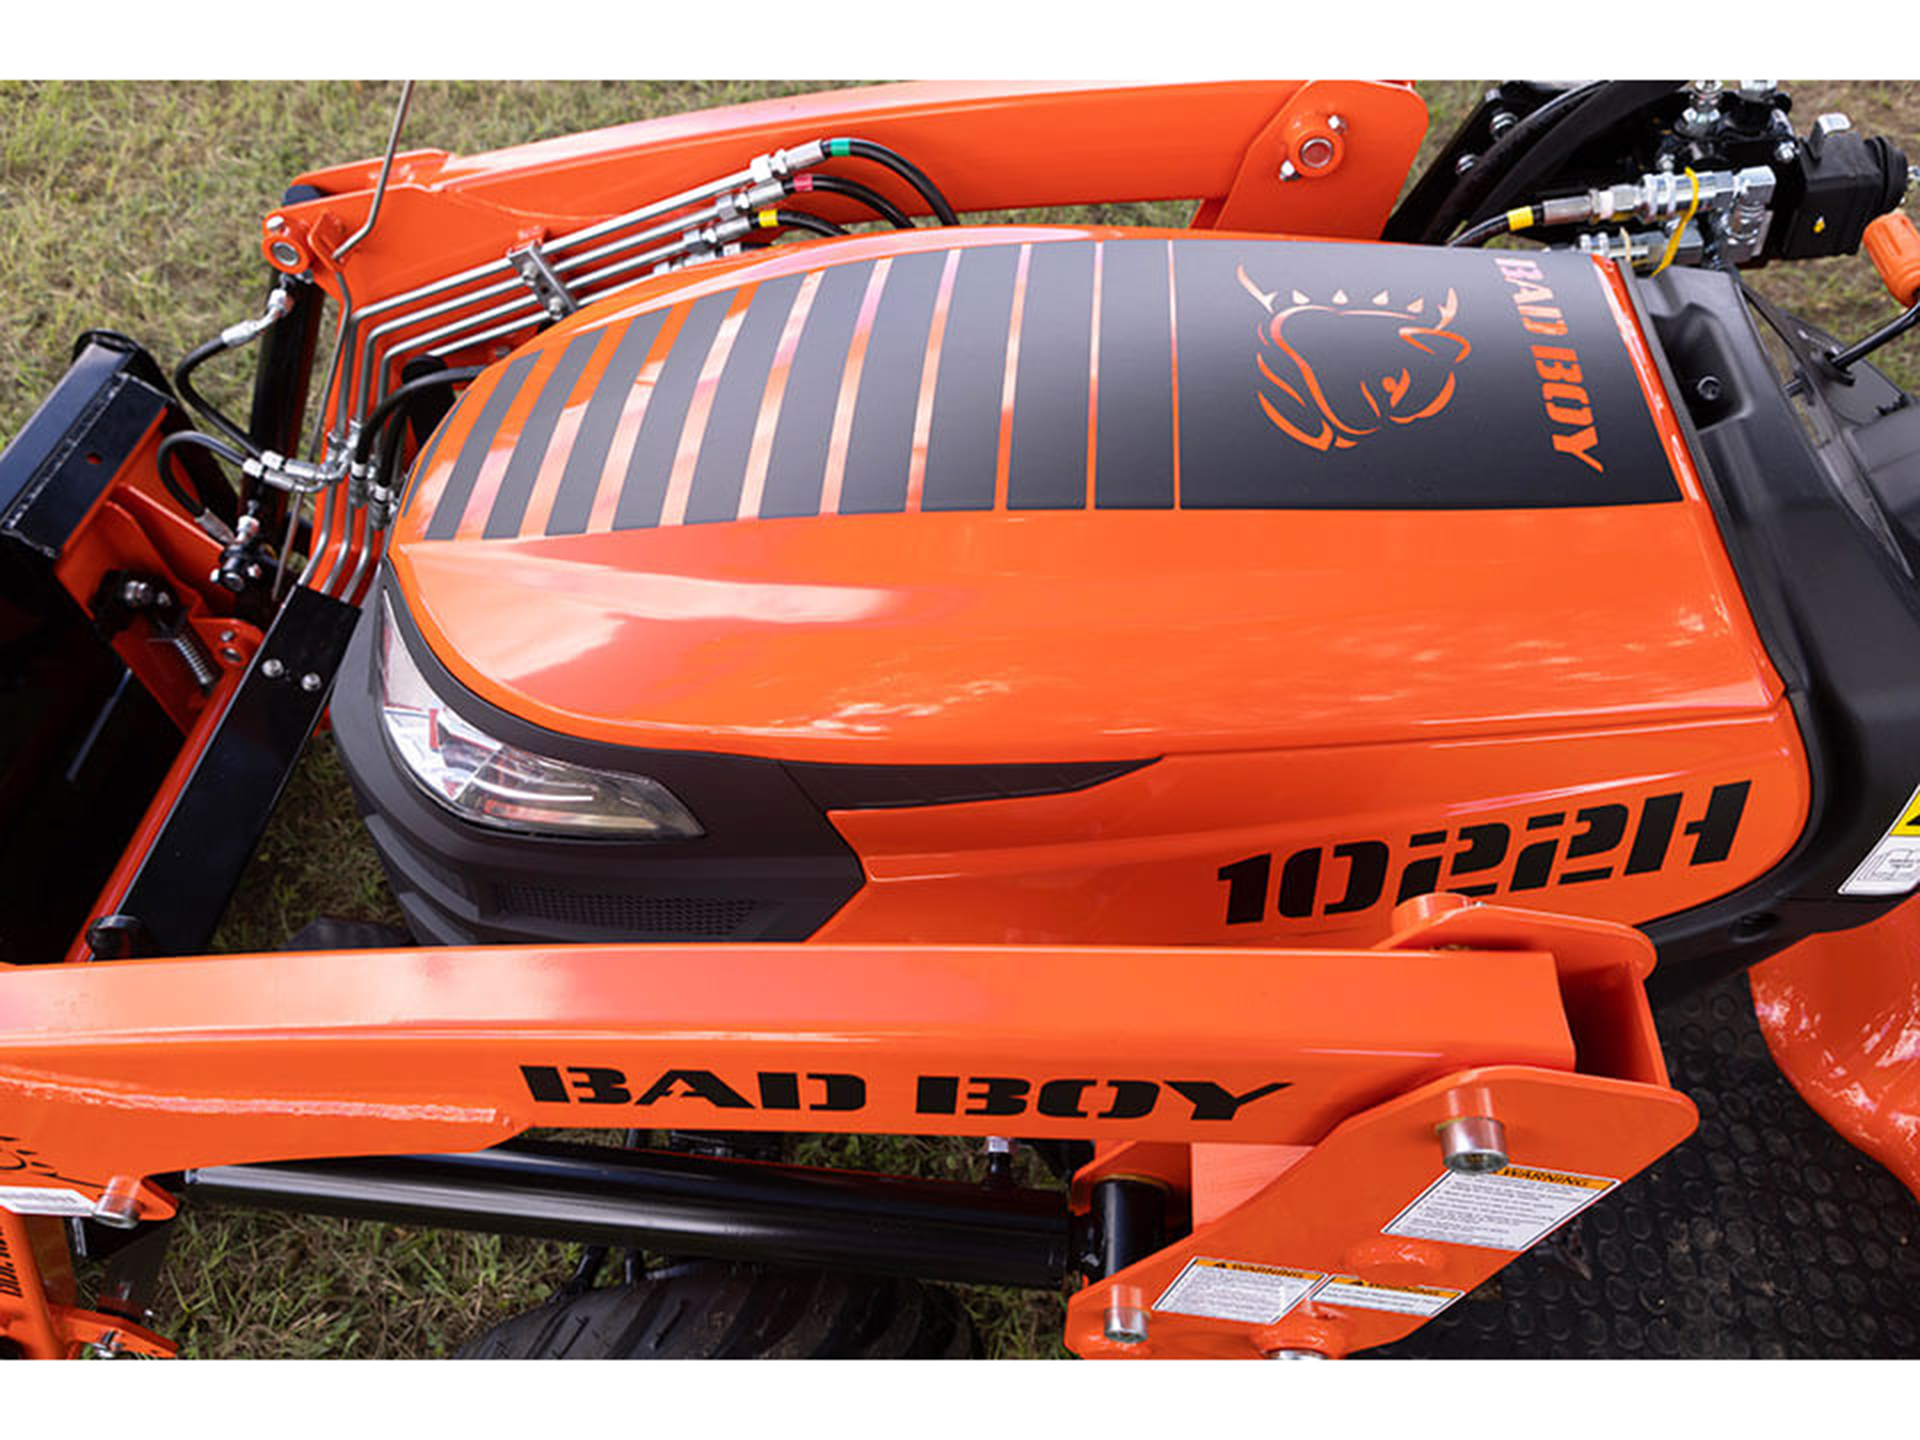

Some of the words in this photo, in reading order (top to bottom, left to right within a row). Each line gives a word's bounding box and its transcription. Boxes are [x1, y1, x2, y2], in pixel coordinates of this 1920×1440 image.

[1494, 257, 1568, 336] BAD
[1531, 345, 1603, 473] BOY
[1218, 780, 1752, 926] 1022H
[520, 1065, 866, 1110] BAD
[916, 1076, 1294, 1121] BOY
[1502, 1167, 1589, 1188] WARNING
